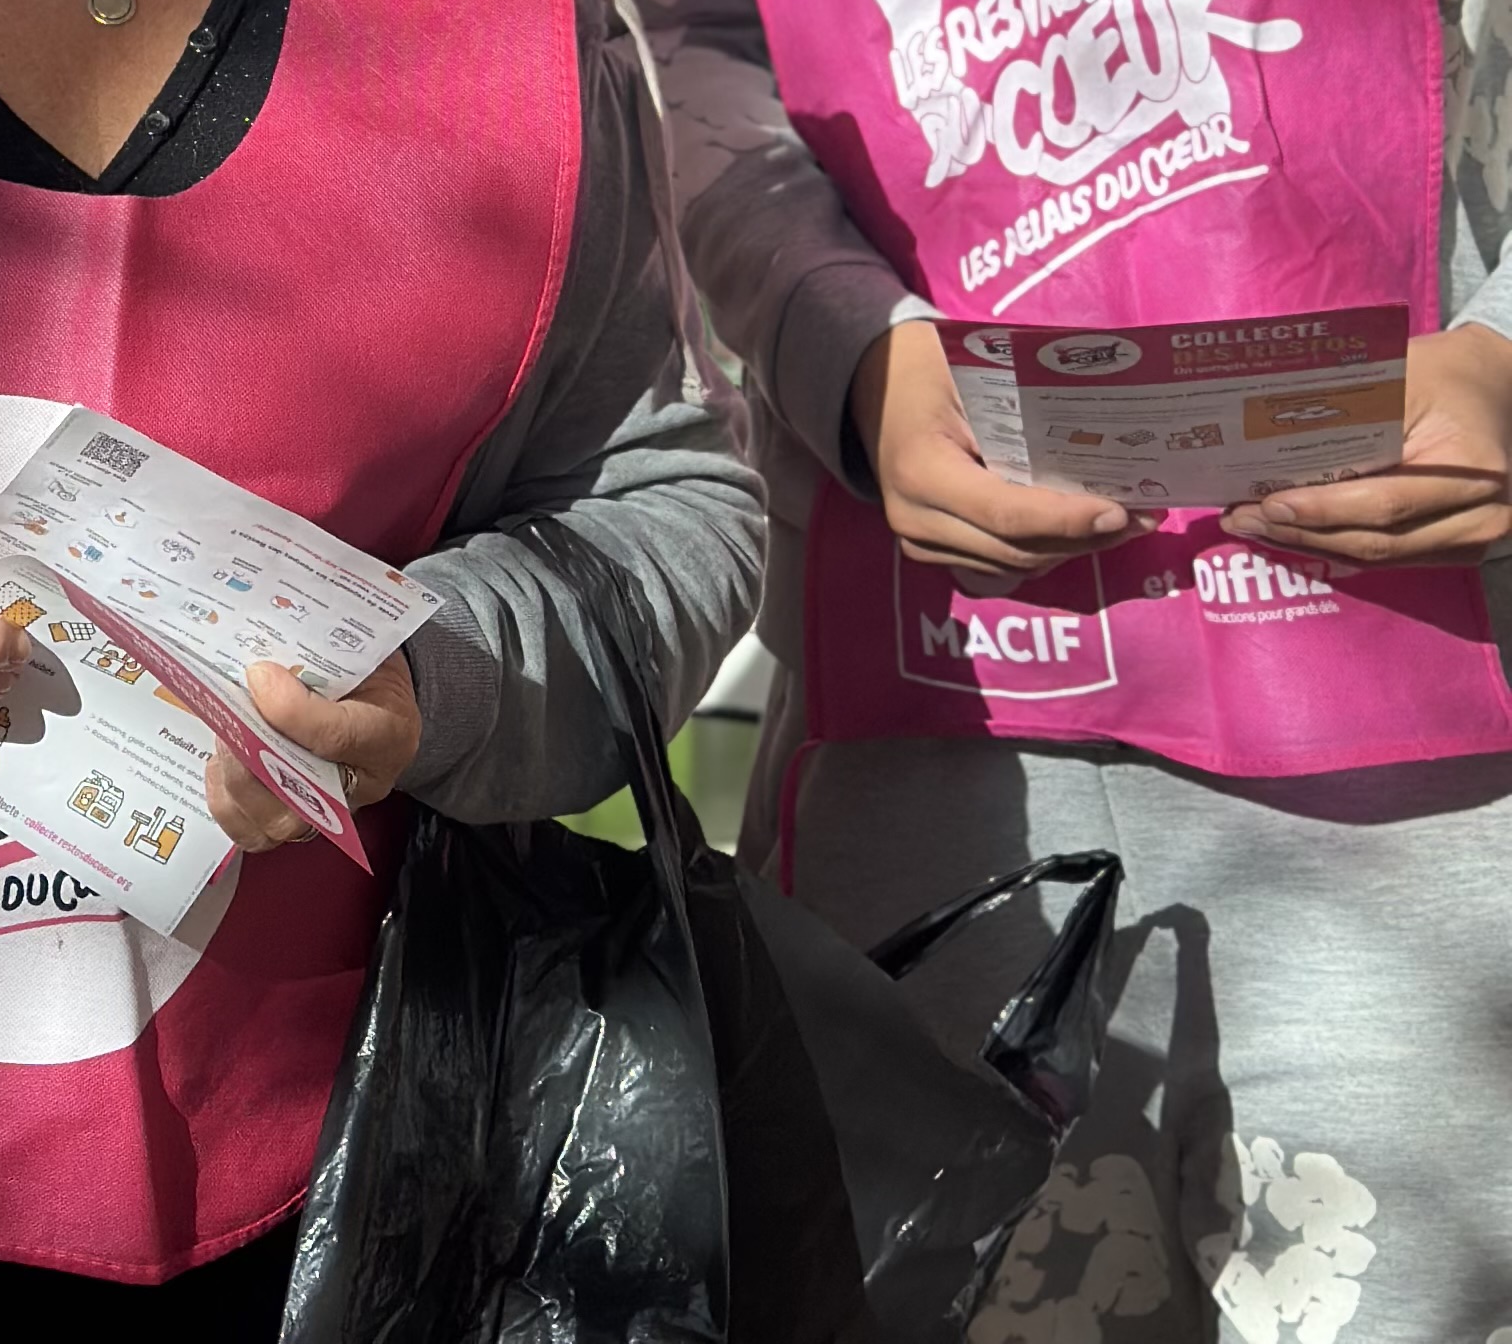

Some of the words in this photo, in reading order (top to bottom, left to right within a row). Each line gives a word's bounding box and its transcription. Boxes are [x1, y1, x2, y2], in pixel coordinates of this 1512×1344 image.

[960, 239, 1002, 292] LES
[1096, 160, 1141, 212] DU
[1171, 322, 1329, 347] COLLECTE
[919, 615, 1082, 663] MACIF
[1141, 570, 1179, 599] et
[1, 873, 49, 911] DU
